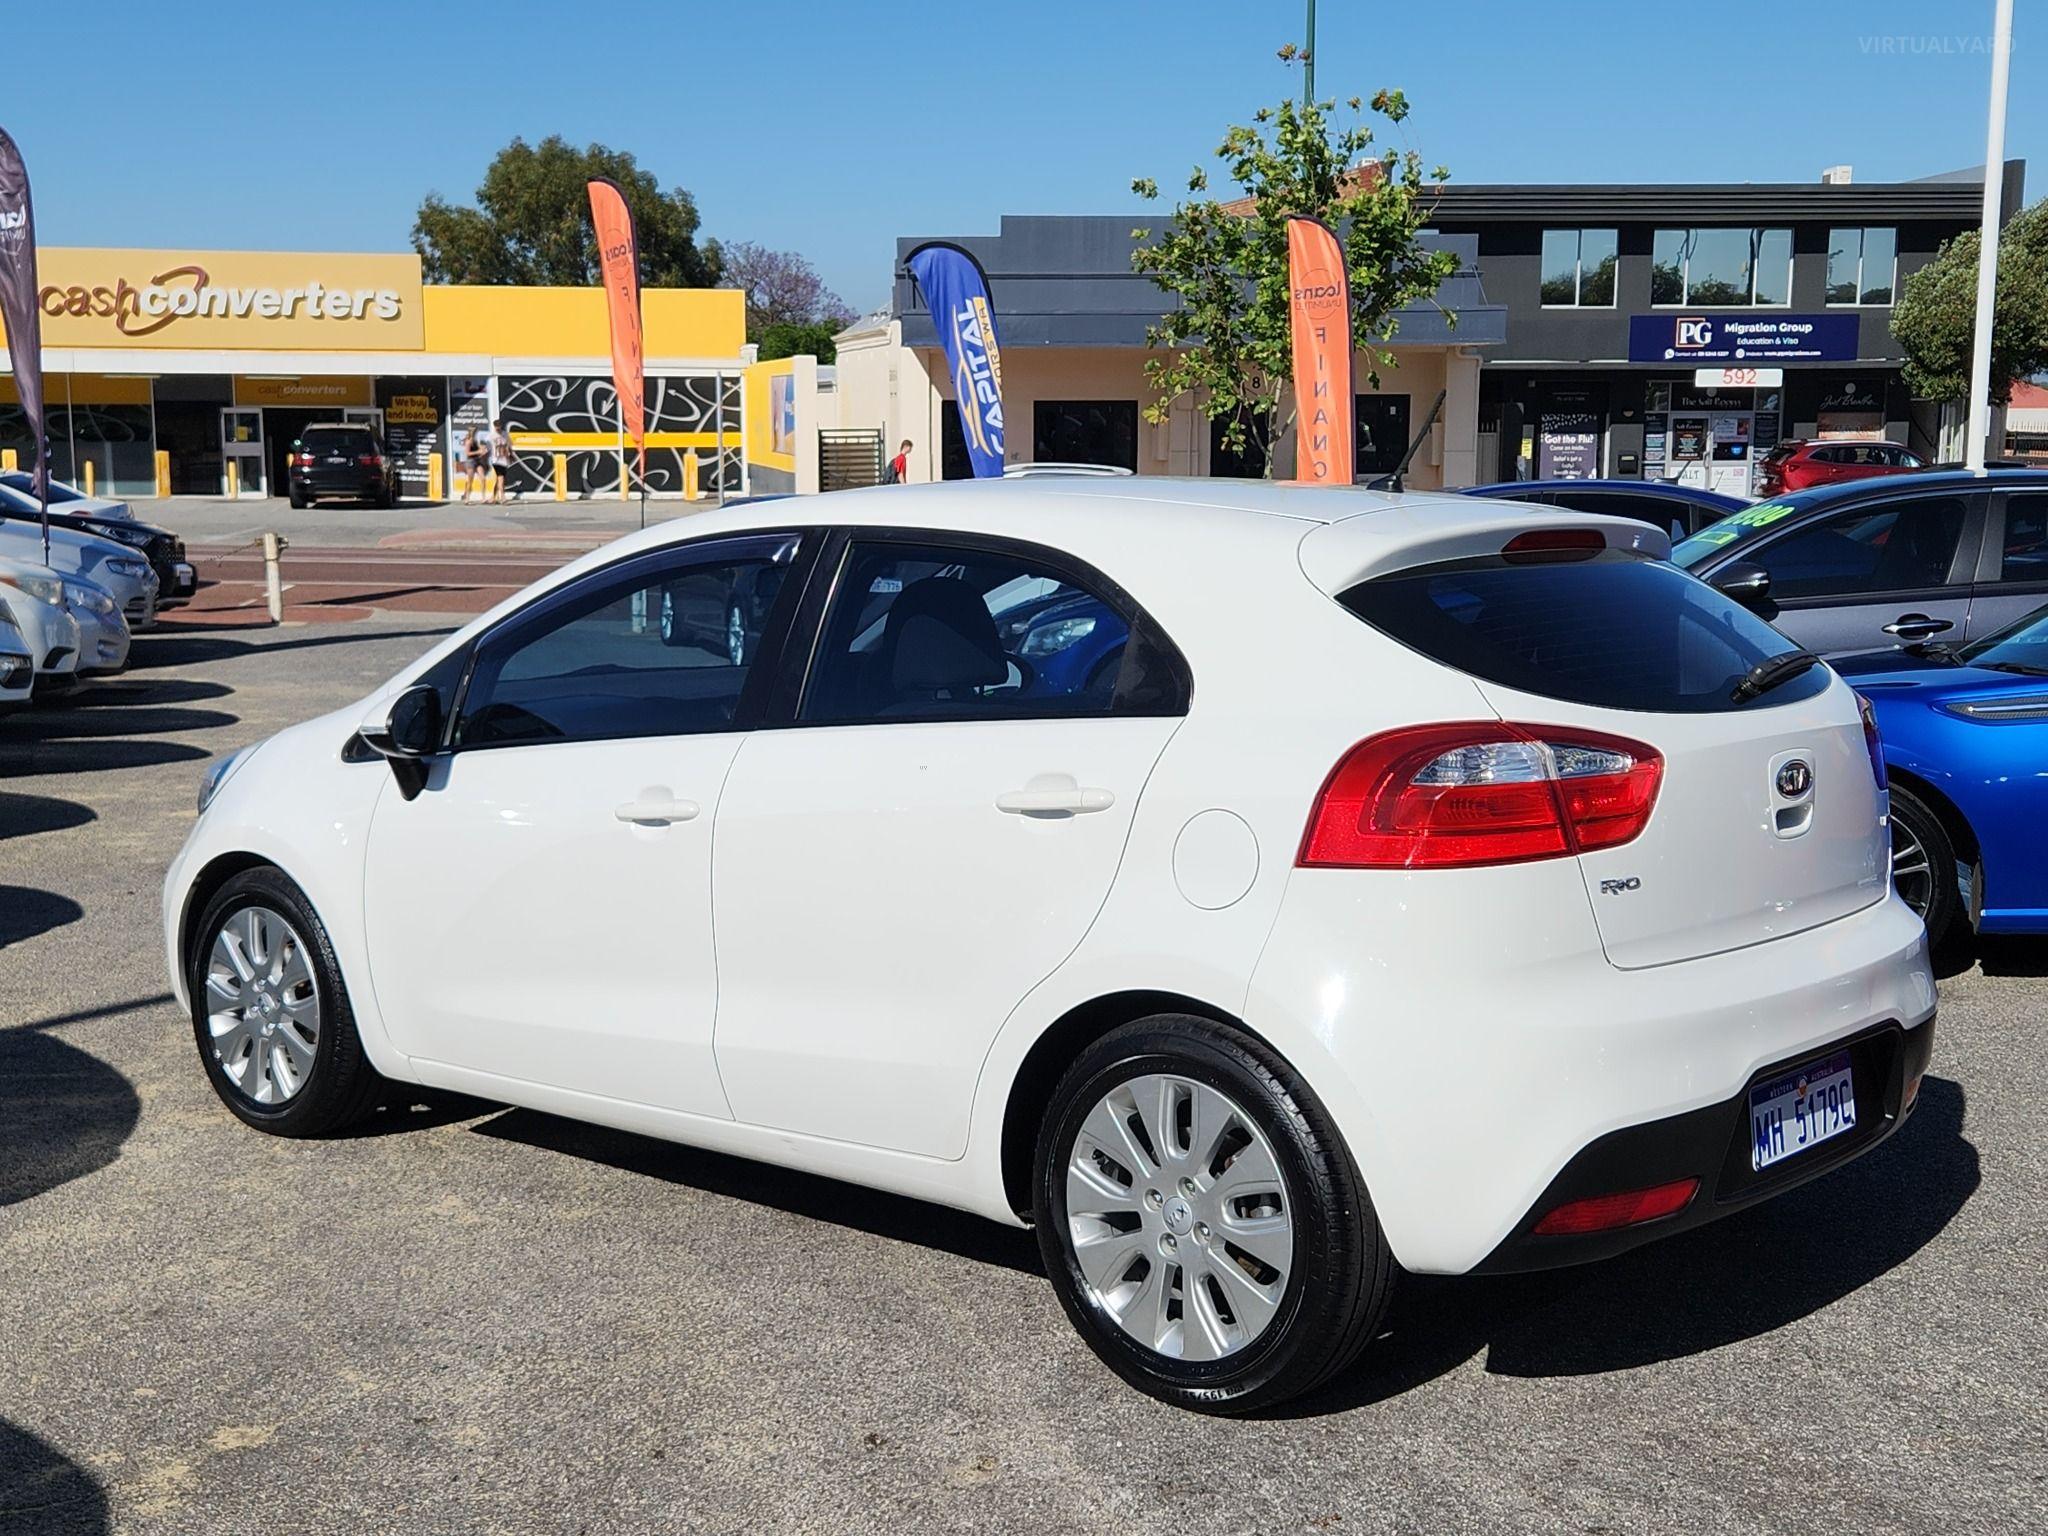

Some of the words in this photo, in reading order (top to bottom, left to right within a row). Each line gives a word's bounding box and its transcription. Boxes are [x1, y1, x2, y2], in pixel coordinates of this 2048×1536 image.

[1679, 320, 1712, 345] PG
[1724, 322, 1777, 335] Migration
[1778, 323, 1814, 335] Group
[1736, 337, 1774, 345] Education
[1782, 337, 1799, 345] Visa
[957, 298, 1004, 455] CAPITAL
[1723, 367, 1757, 384] 592
[1545, 434, 1561, 444] Got
[1754, 1106, 1785, 1162] MH
[1794, 1079, 1851, 1144] 5179C
